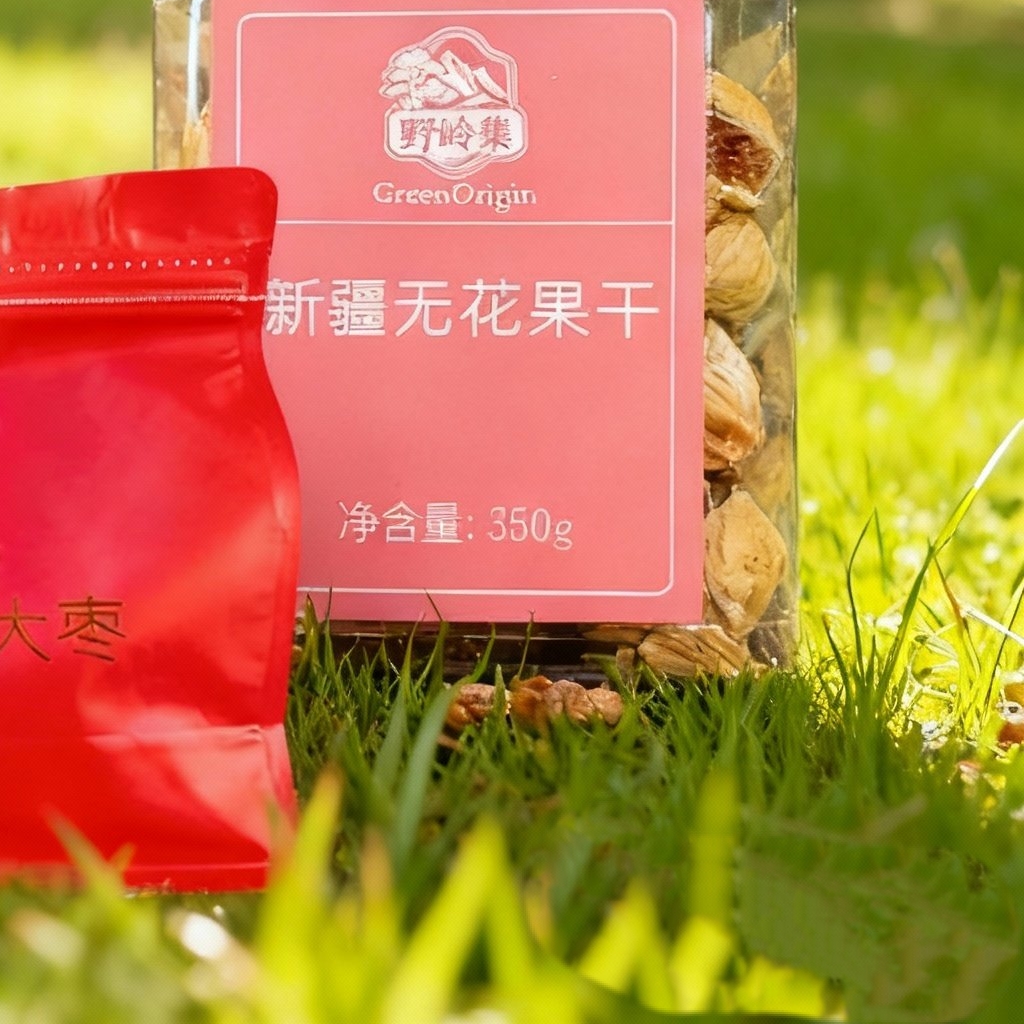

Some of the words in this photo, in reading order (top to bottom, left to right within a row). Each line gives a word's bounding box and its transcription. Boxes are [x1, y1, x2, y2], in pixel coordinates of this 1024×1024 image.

[265, 278, 660, 339] 新疆无花果干
[487, 505, 573, 551] 350g
